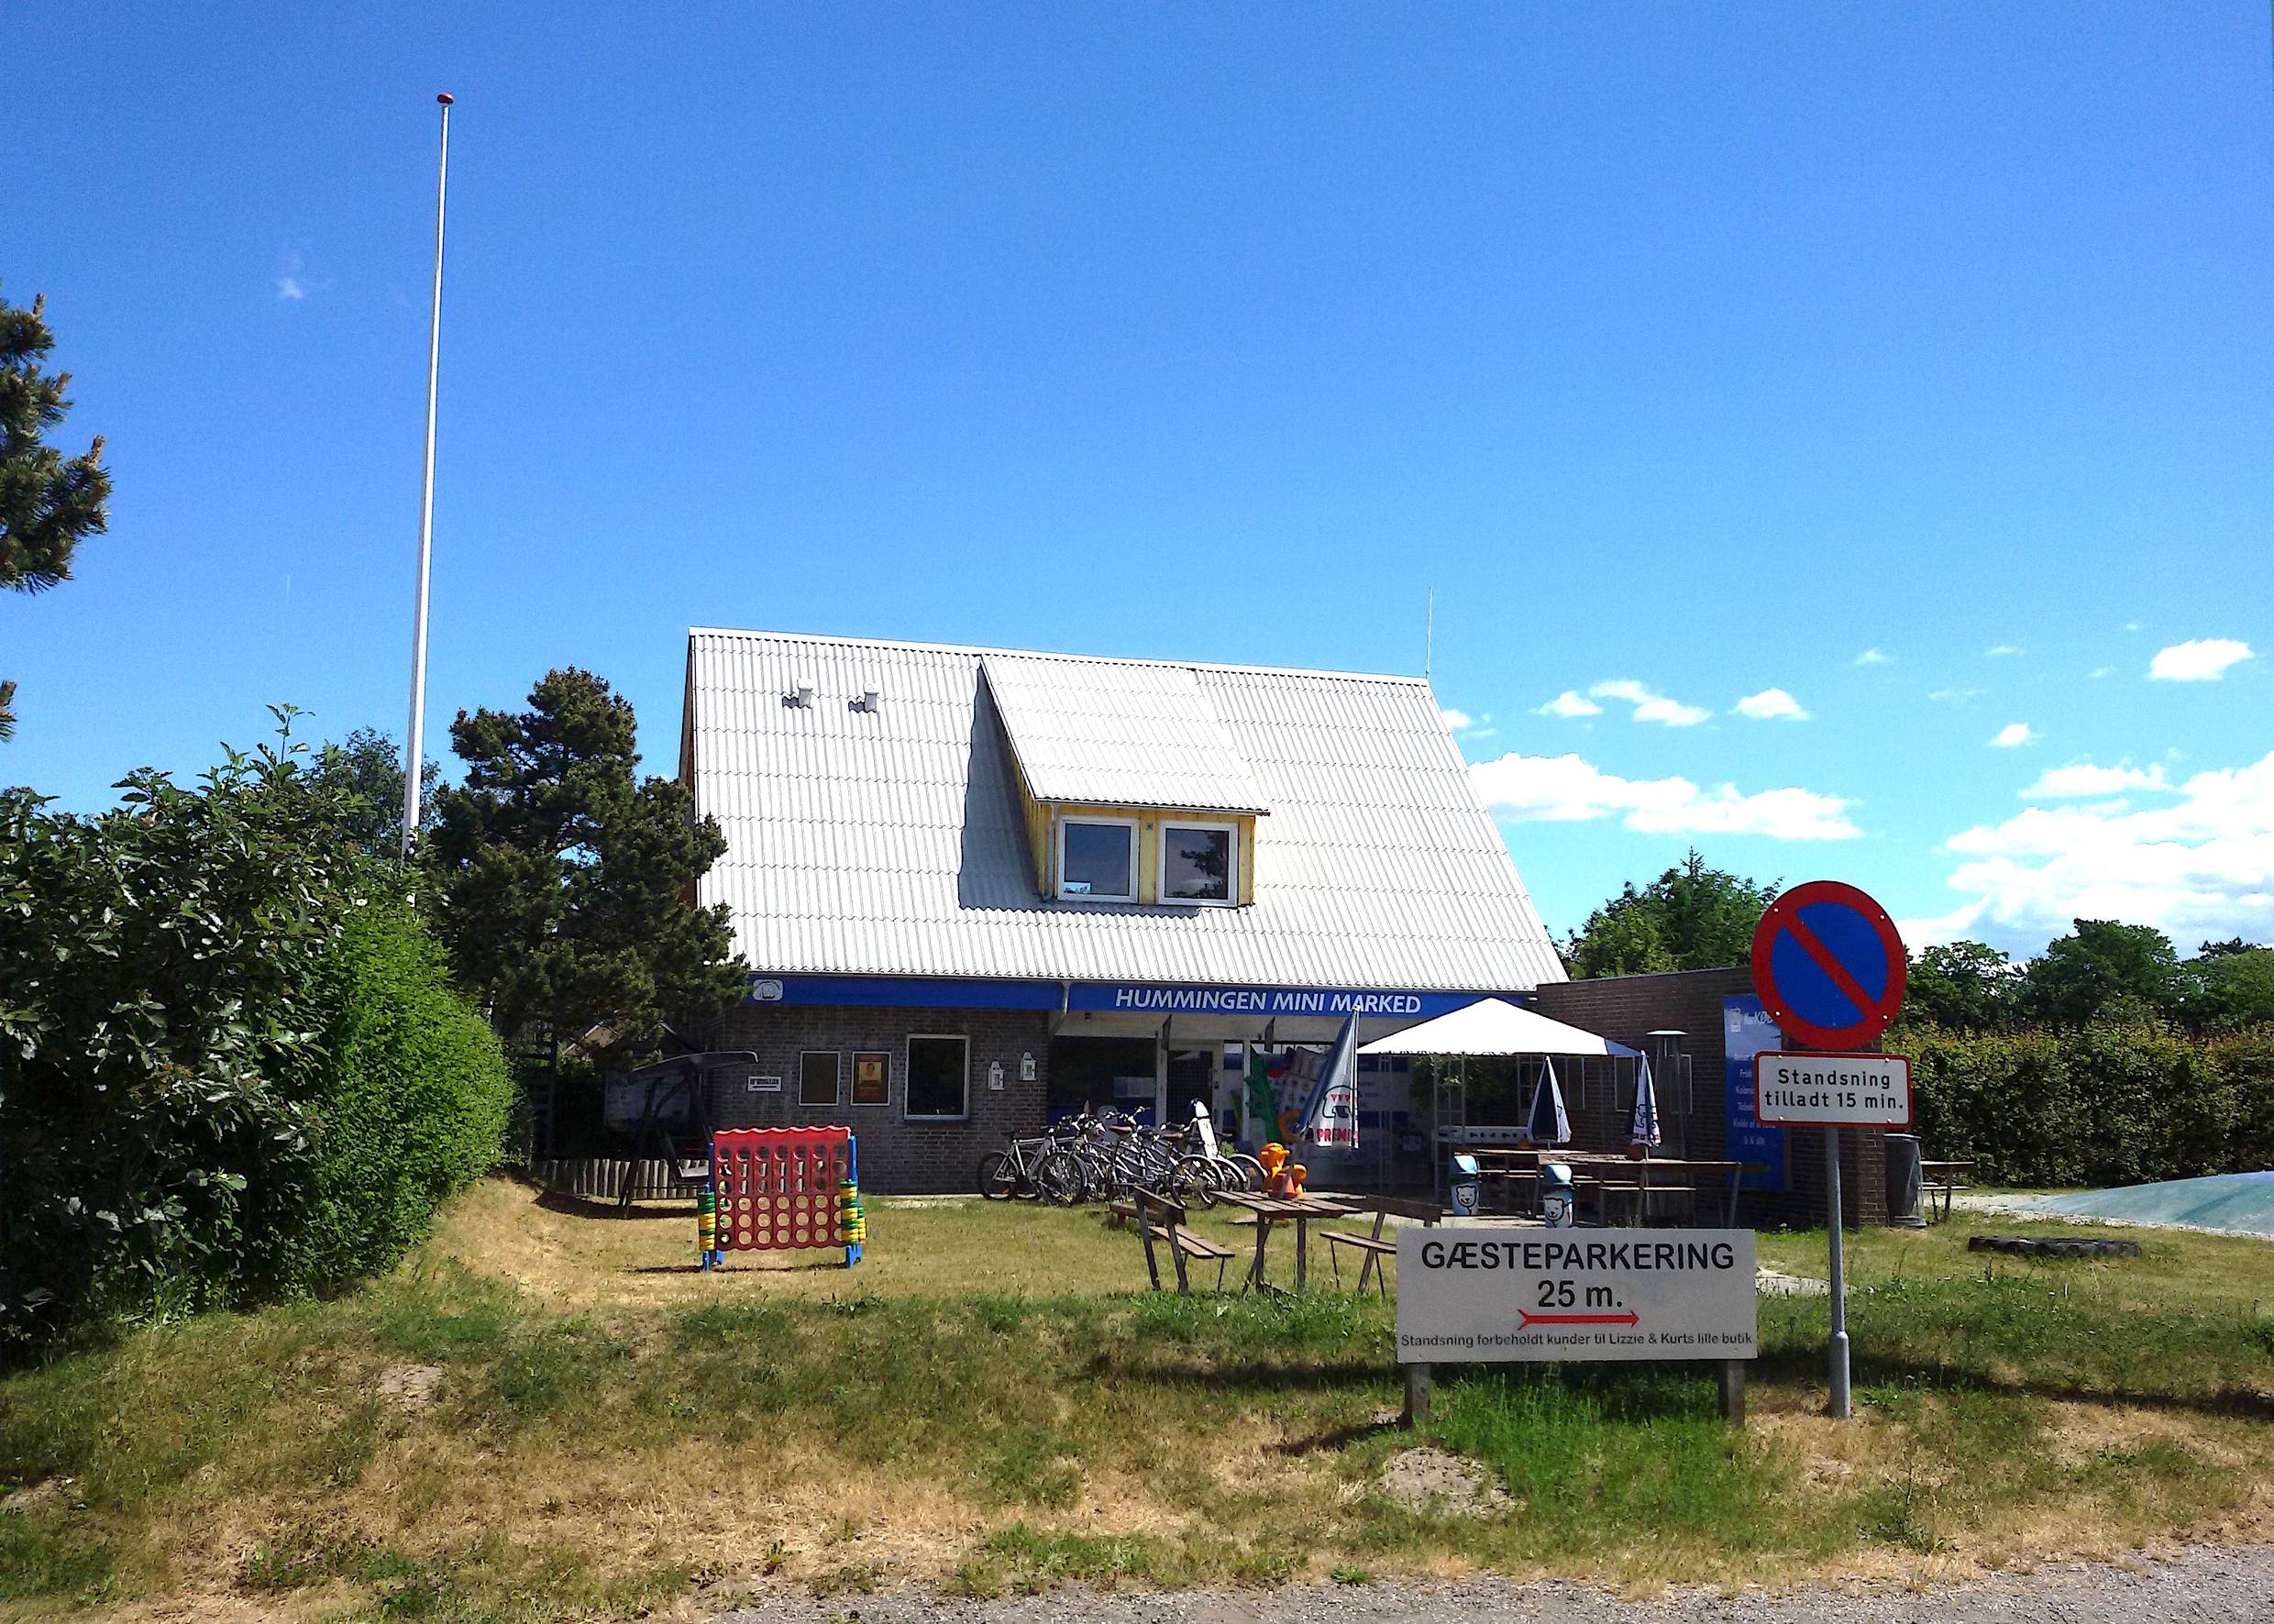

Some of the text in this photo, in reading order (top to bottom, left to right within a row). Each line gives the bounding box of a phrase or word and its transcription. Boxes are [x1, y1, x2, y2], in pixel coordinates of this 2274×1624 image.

[1115, 989, 1421, 1013] HUMMINGEN MINI MARKED
[1778, 1068, 1890, 1089] Standsning
[1765, 1090, 1829, 1108] tilladt
[1837, 1092, 1857, 1108] 15
[1865, 1094, 1904, 1109] min.
[1421, 1241, 1734, 1270] GÆSTEPARKERING
[1537, 1280, 1623, 1308] 25 m.
[1401, 1334, 1474, 1348] Standsning
[1477, 1333, 1543, 1345] forbeholdt
[1547, 1333, 1590, 1344] kunder
[1595, 1333, 1606, 1344] til
[1609, 1333, 1644, 1344] Lizzie
[1648, 1332, 1657, 1344] &
[1661, 1332, 1694, 1344] Kurts
[1697, 1332, 1718, 1344] lille
